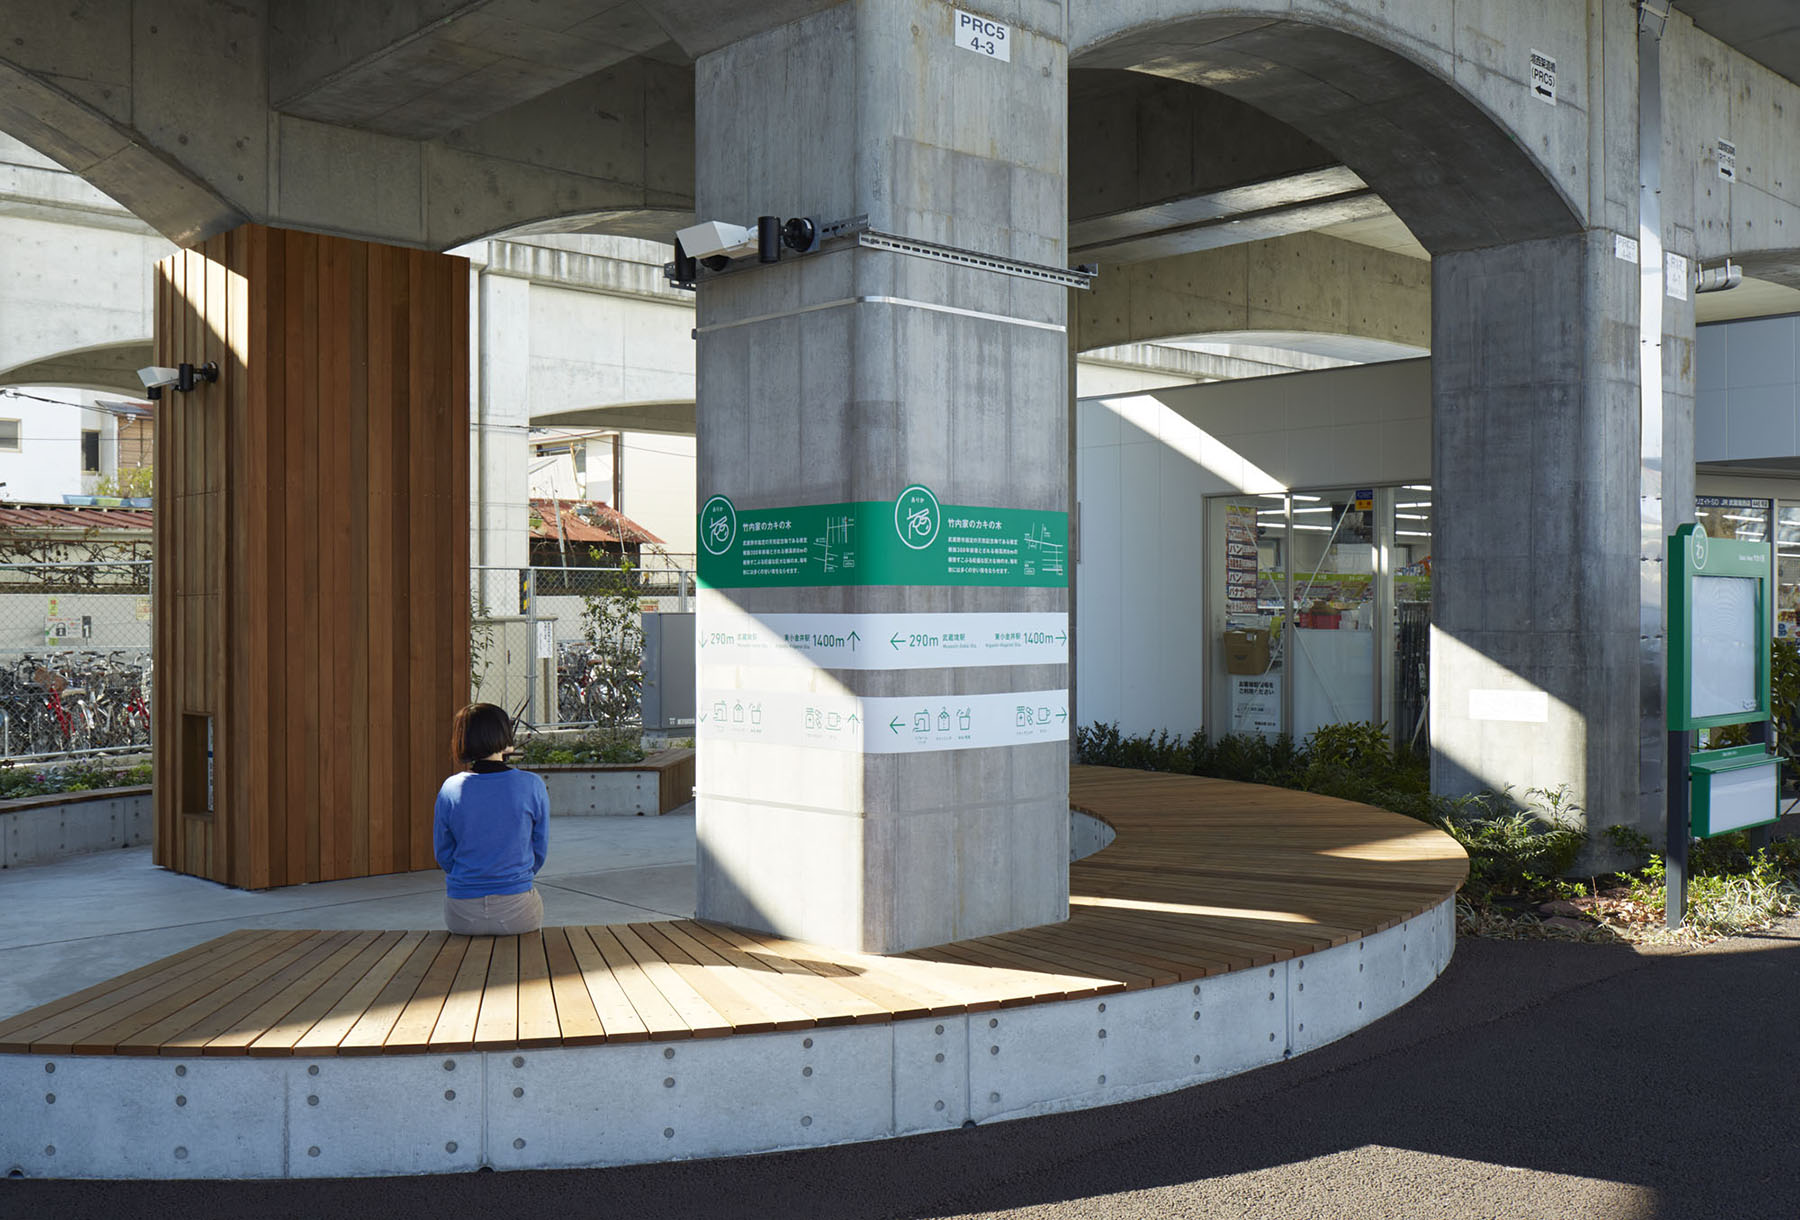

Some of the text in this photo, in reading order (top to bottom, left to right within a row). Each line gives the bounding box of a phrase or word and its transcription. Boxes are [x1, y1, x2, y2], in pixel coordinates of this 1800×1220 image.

[961, 14, 1005, 40] PRC5
[970, 37, 995, 55] 4-3
[743, 520, 792, 532] 竹内家のカキの木
[948, 518, 1003, 530] 竹内家のカキの木
[710, 632, 735, 645] 290m
[813, 634, 846, 648] 1400m
[909, 634, 939, 647] 290m
[942, 633, 966, 641] 武蔵境駅
[995, 632, 1021, 641] 東小金井駅
[1024, 632, 1054, 645] 1400m
